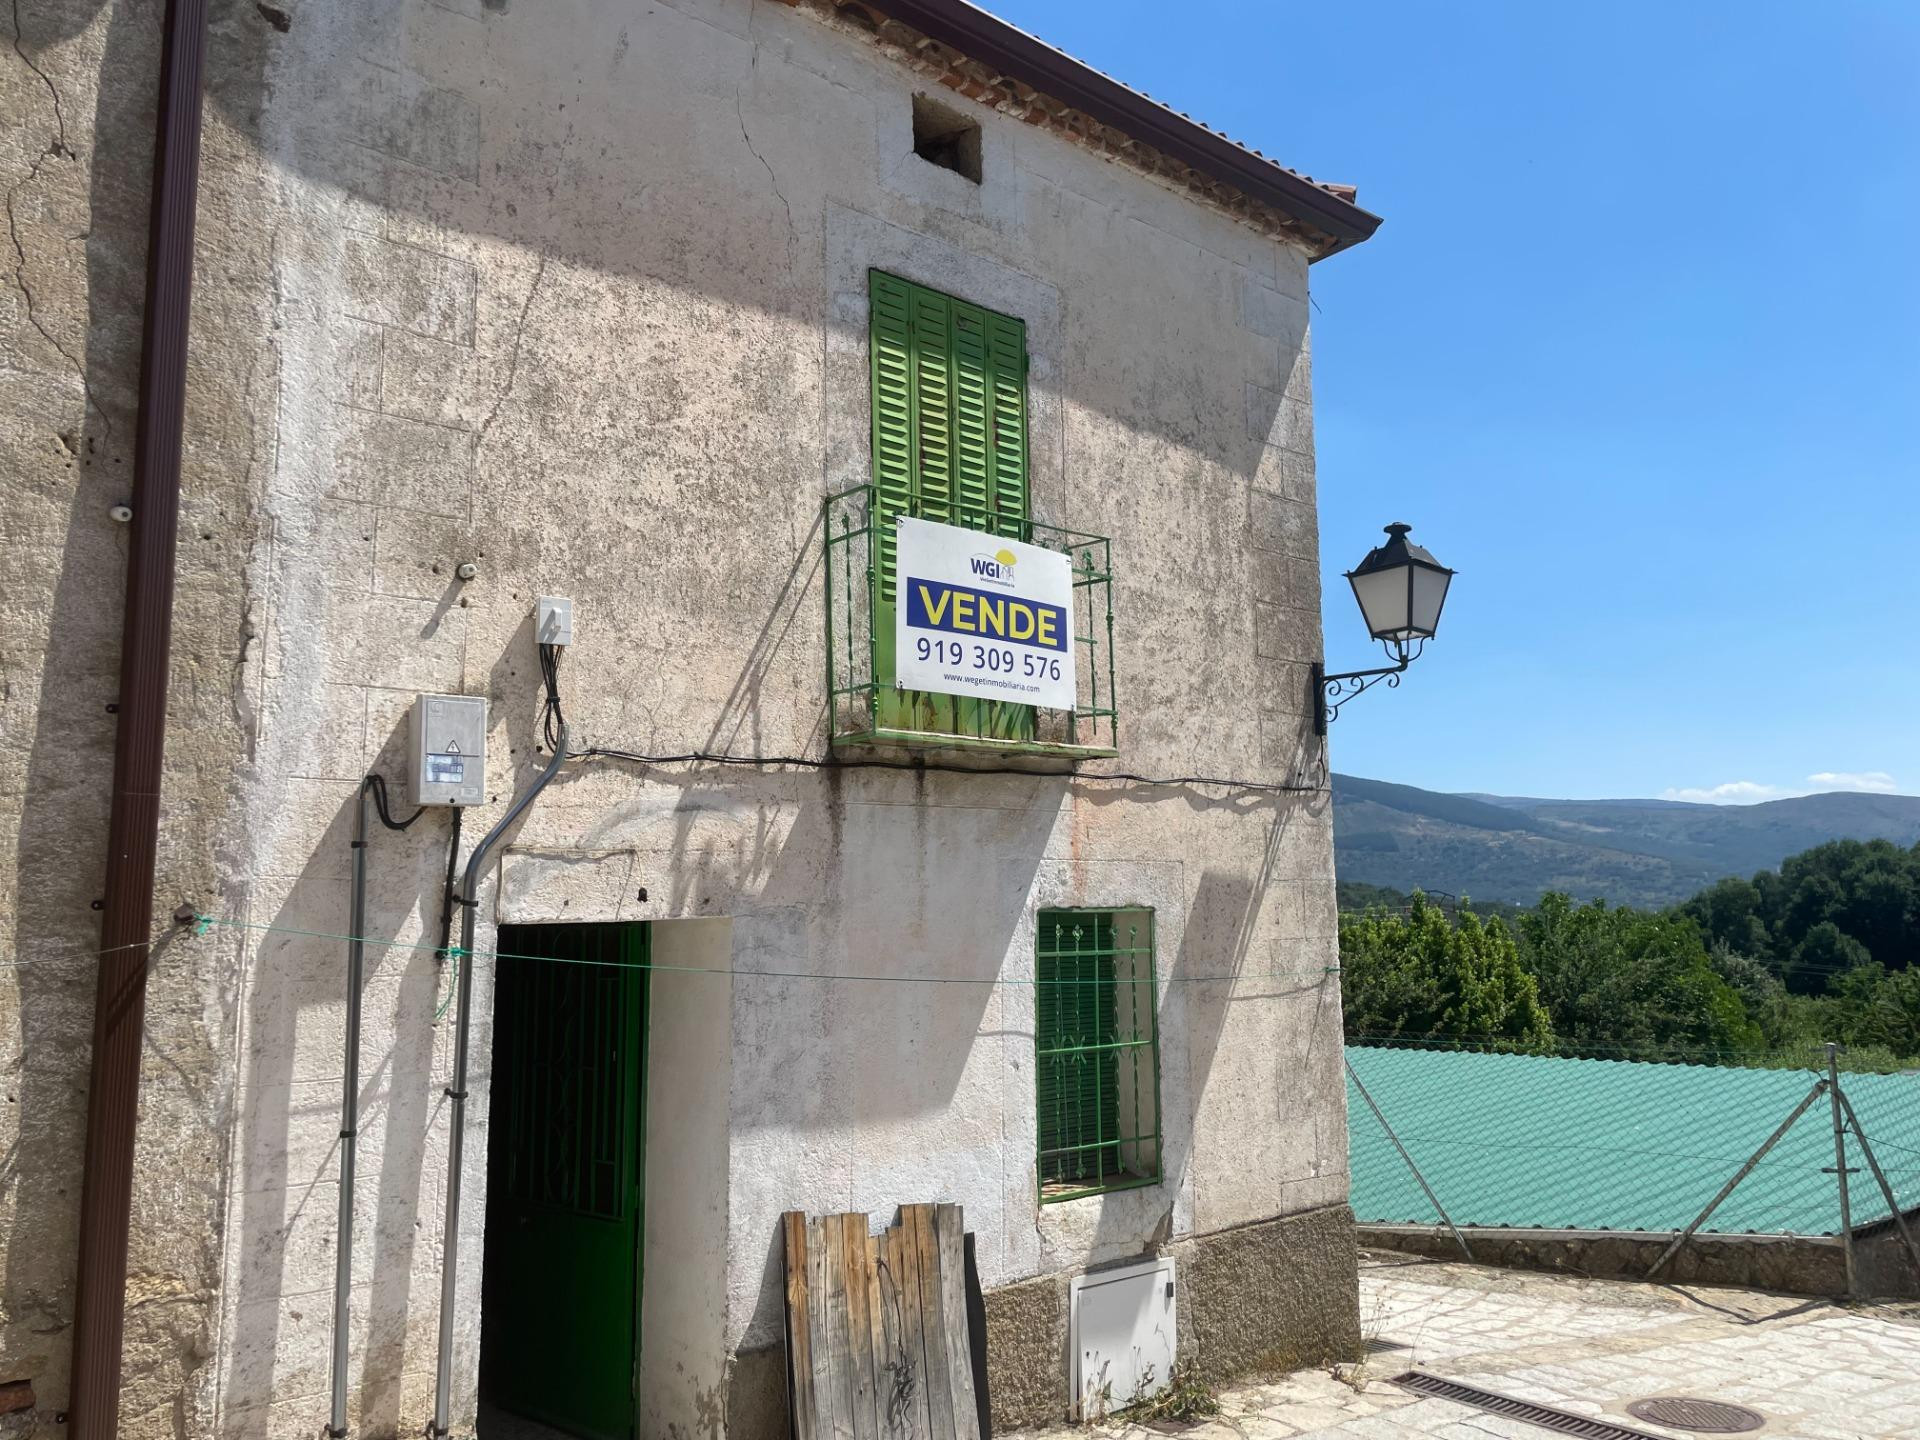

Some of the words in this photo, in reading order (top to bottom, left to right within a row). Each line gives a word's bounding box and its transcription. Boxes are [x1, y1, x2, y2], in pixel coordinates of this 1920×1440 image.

[970, 558, 1000, 579] WGI
[918, 585, 1058, 646] VENDE
[917, 637, 963, 665] 919
[973, 645, 1014, 672] 309
[1024, 654, 1061, 681] 576
[943, 673, 1041, 693] www.wegetinmobiliaria.com
